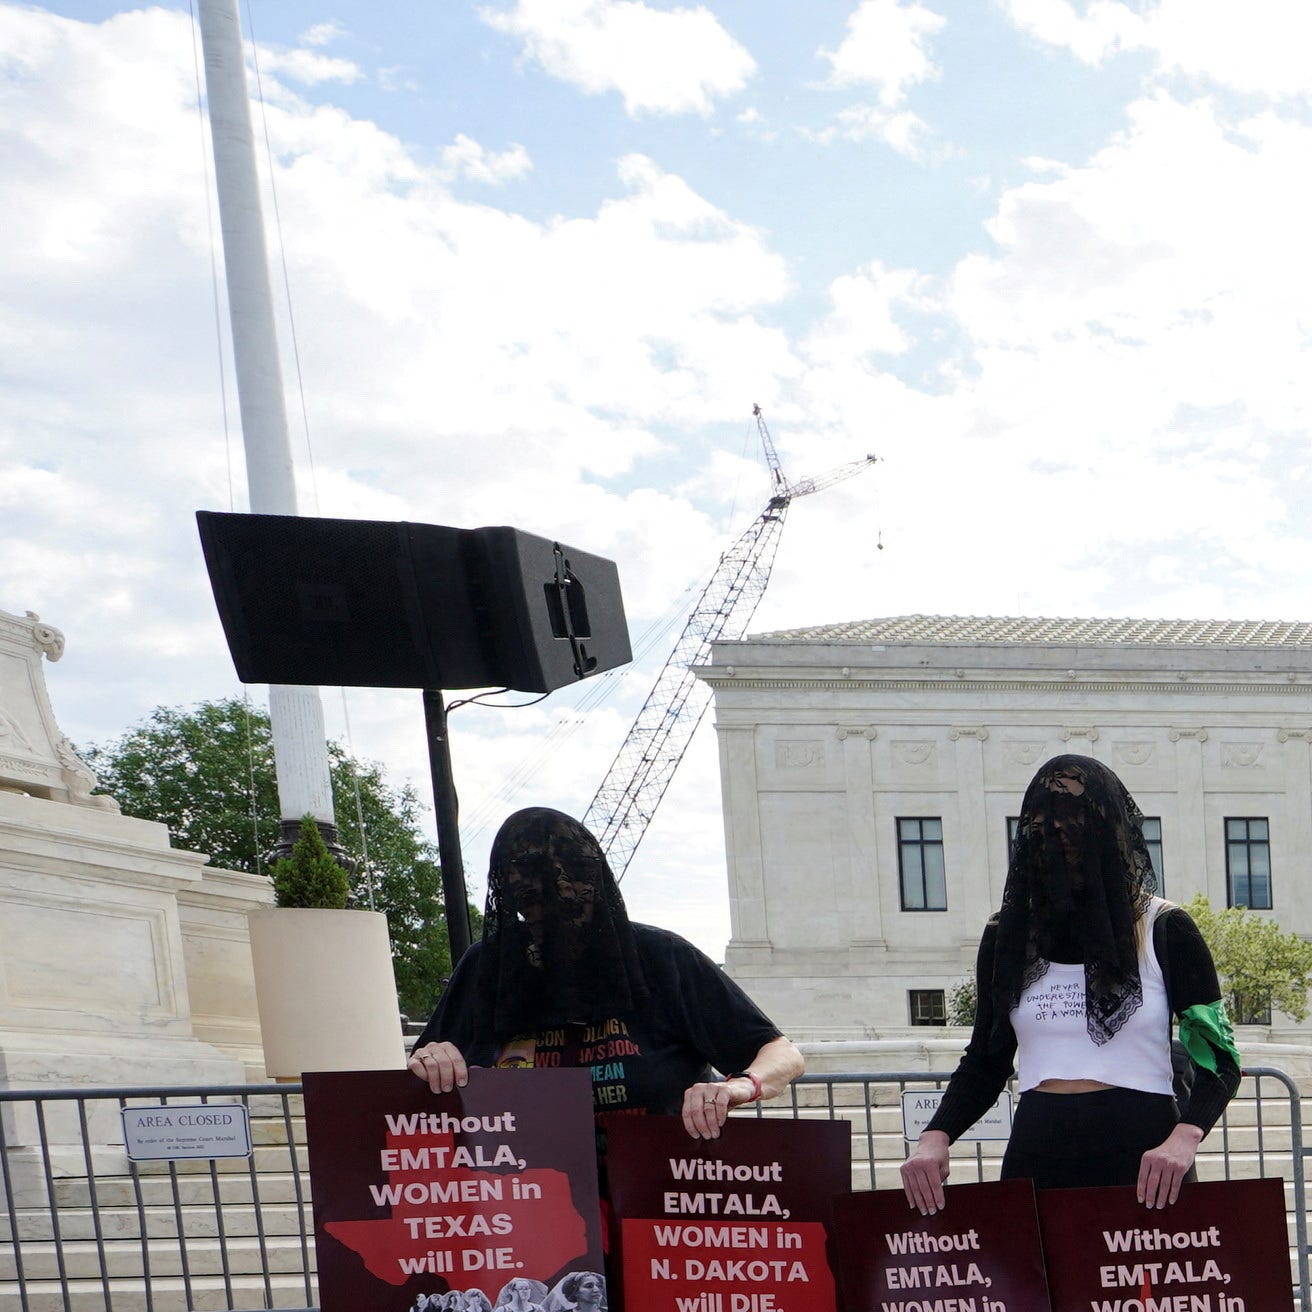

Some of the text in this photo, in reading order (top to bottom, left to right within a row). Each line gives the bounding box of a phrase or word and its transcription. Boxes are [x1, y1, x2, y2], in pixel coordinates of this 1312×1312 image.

[1026, 992, 1086, 1002] UNDERESTIM
[1050, 983, 1079, 992] NEVER
[1036, 1009, 1086, 1020] OF A WOM
[1037, 1001, 1086, 1010] THE POWE
[598, 1085, 627, 1104] HER
[915, 1099, 939, 1109] ARE
[137, 1114, 232, 1128] AREA CLOSED
[385, 1112, 516, 1135] Without
[381, 1145, 526, 1170] EMTALA,
[670, 1159, 782, 1181] Without
[369, 1178, 541, 1206] WOMEN in
[664, 1192, 790, 1219] EMTALA,
[404, 1214, 513, 1239] TEXAS
[654, 1226, 801, 1248] WOMEN in
[885, 1229, 979, 1254] Without
[1103, 1227, 1220, 1252] Without
[398, 1248, 523, 1274] will DIE.
[651, 1259, 809, 1281] N. DAKOTA
[886, 1263, 991, 1289] EMTALA,
[1100, 1260, 1230, 1287] EMTALA,
[676, 1292, 722, 1312] will
